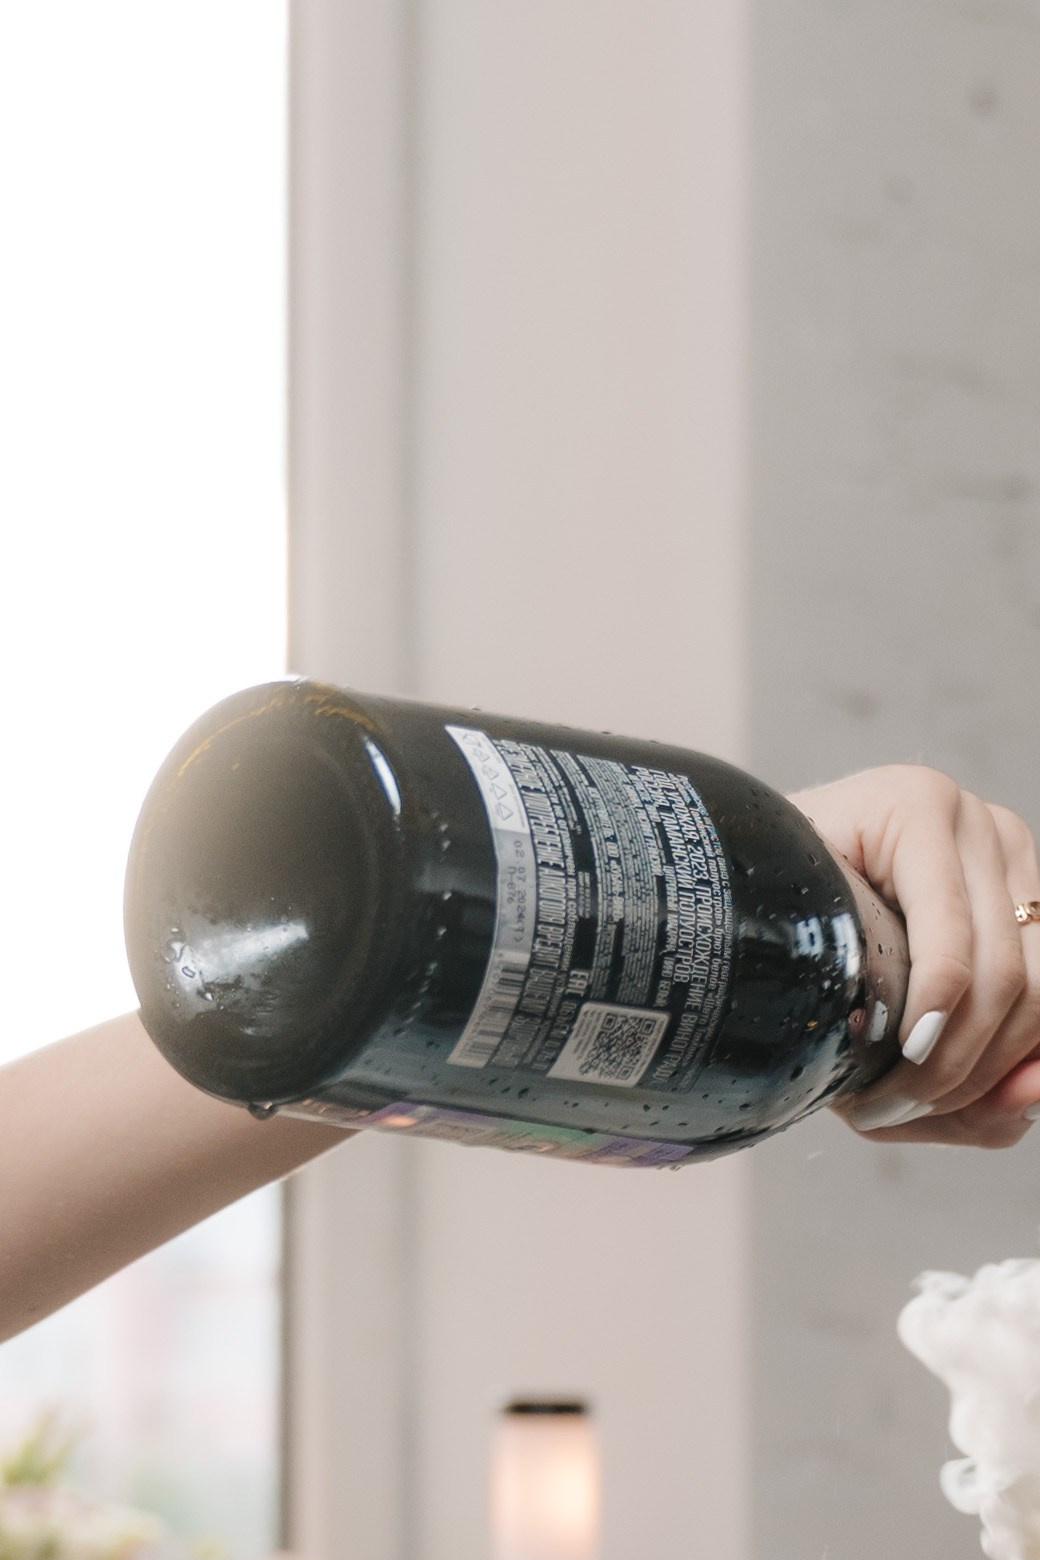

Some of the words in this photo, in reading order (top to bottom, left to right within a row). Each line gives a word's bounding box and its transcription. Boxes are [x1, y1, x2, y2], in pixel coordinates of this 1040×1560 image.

[631, 766, 670, 807] РОССИЯ,
[521, 790, 564, 868] УПОТРЕБЛЕНИЕ
[558, 819, 575, 875] ограничен
[606, 842, 620, 857] ООО
[660, 812, 694, 889] ТАМАНСКИЙ
[538, 867, 567, 924] АЛКОГОЛЯ
[565, 878, 577, 899] при
[649, 769, 676, 789] ГОД
[664, 790, 699, 842] УРОЖАЯ:
[684, 883, 713, 1010] ПРОИСХОЖДЕНИЕ
[708, 859, 723, 925] полуостров»
[532, 924, 564, 968] ВРЕДИТ
[672, 891, 695, 985] ПОЛУОСТРОВ.
[711, 928, 725, 954] брют
[708, 959, 724, 989] белое
